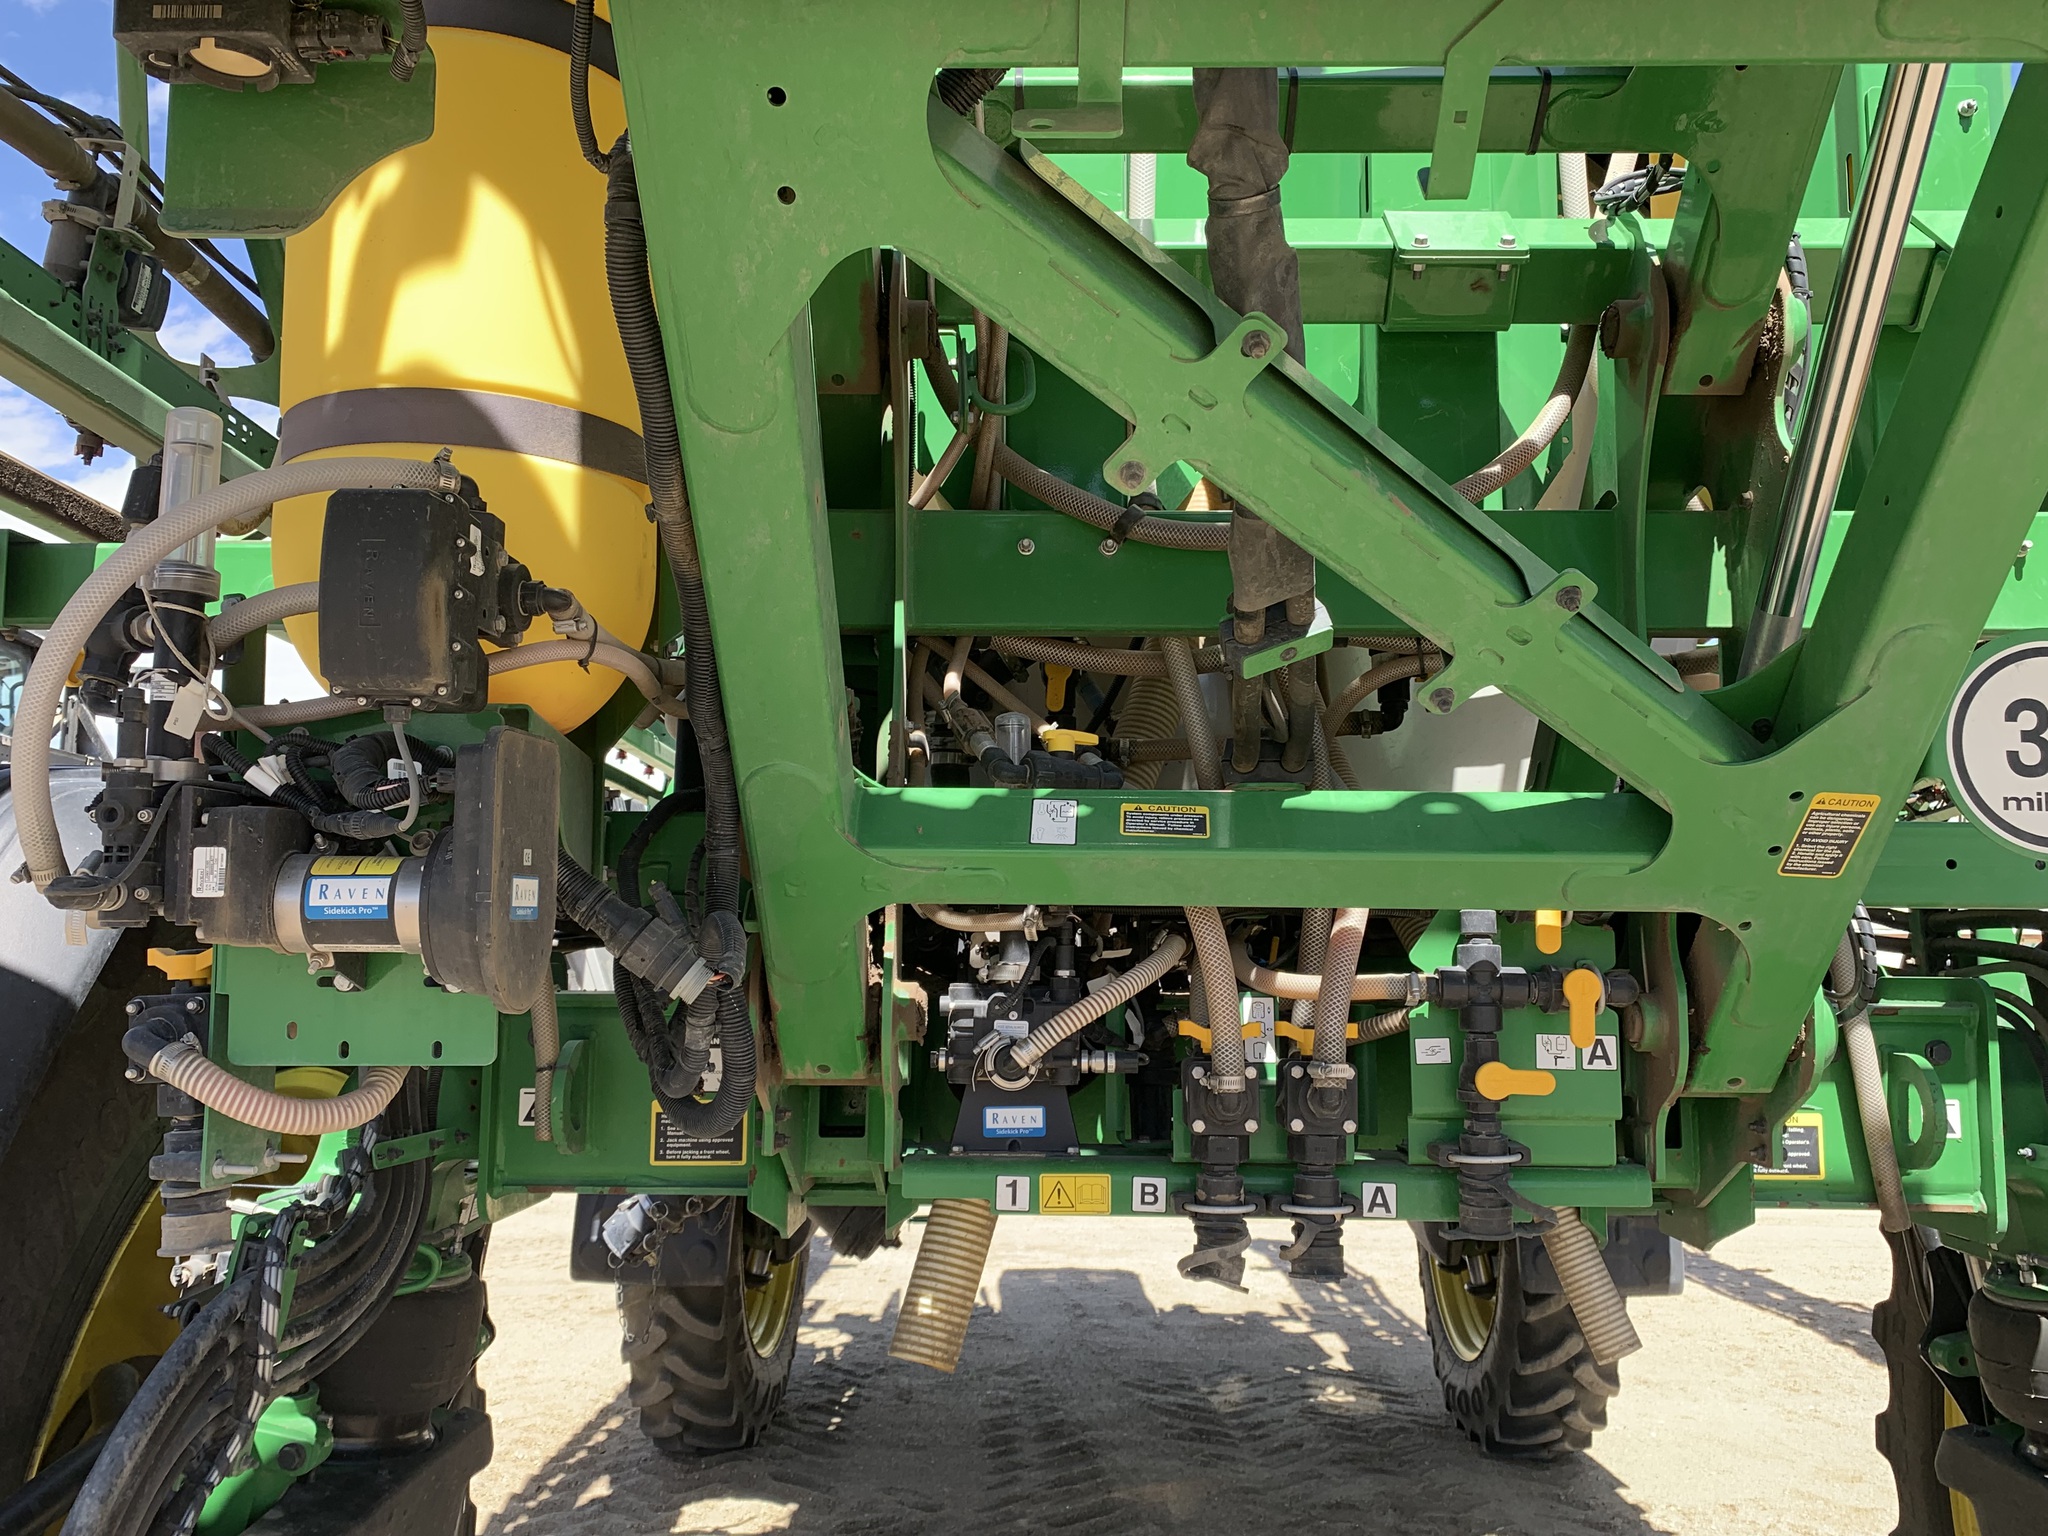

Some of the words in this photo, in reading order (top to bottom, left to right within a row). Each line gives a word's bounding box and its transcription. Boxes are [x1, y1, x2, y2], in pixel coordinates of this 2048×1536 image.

[364, 549, 379, 617] RAVEN
[1828, 798, 1874, 807] CAUTION
[318, 884, 385, 900] RAVEN
[515, 884, 535, 901] RAVEN
[324, 906, 357, 914] Sidekick
[1588, 1038, 1612, 1065] A
[992, 1112, 1037, 1124] RAVEN
[1006, 1180, 1018, 1206] 1
[1140, 1183, 1158, 1206] B
[1367, 1186, 1392, 1214] A
